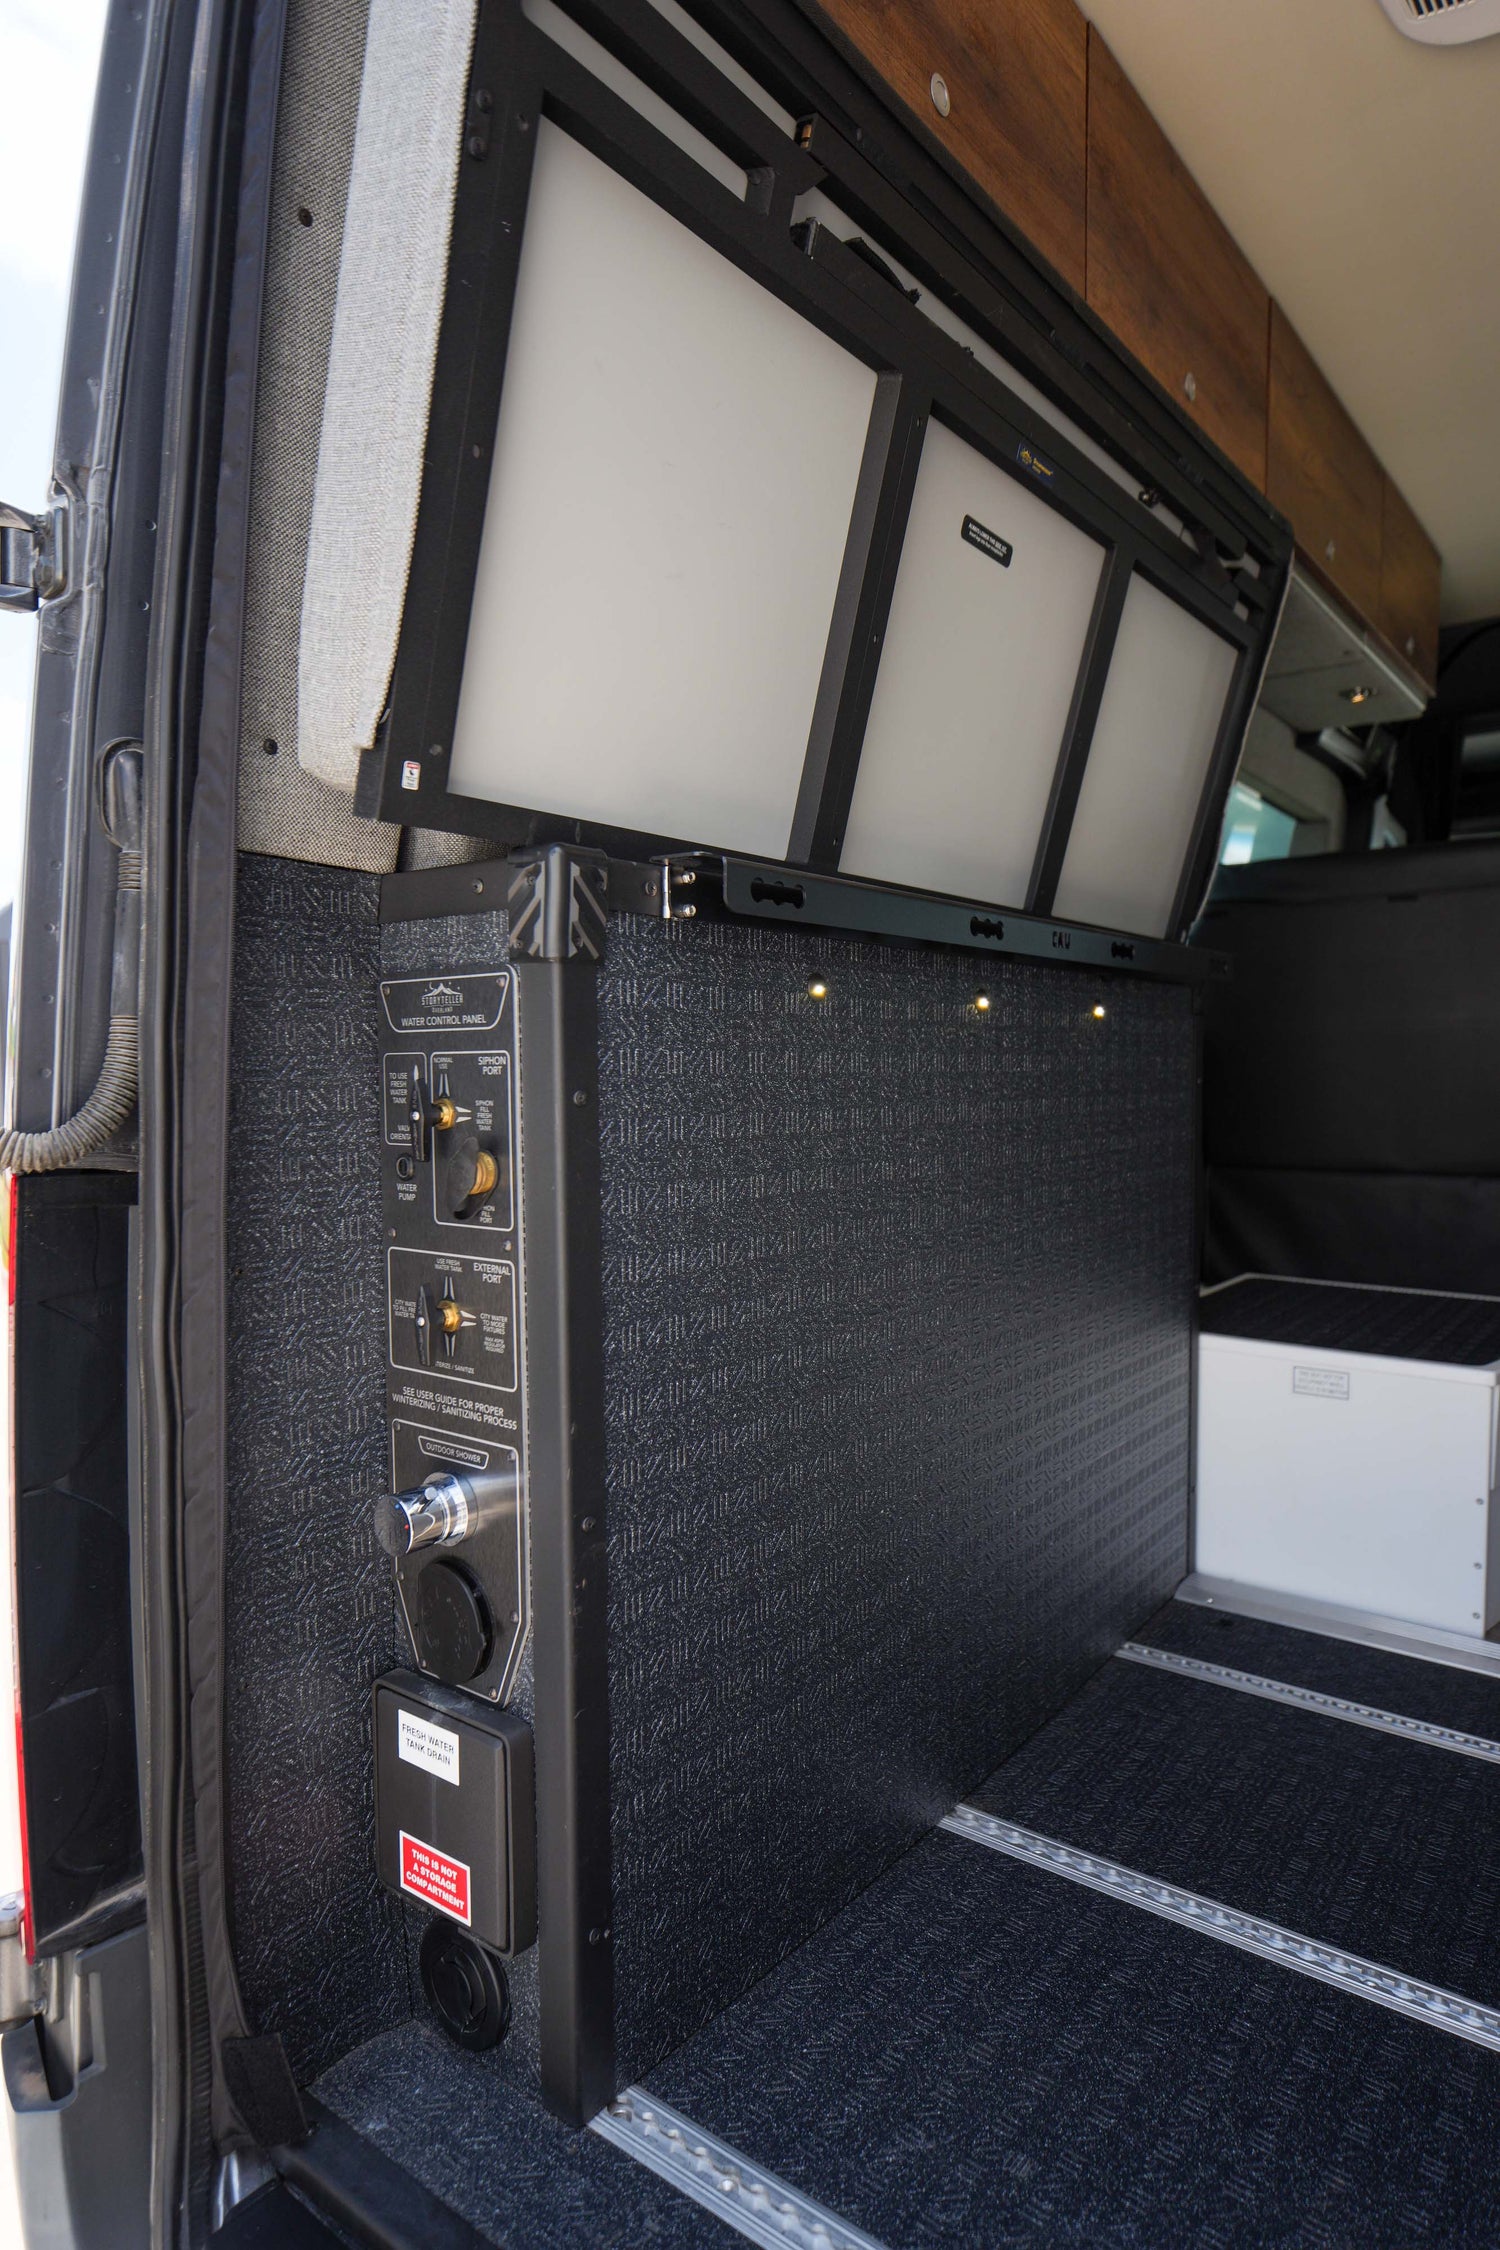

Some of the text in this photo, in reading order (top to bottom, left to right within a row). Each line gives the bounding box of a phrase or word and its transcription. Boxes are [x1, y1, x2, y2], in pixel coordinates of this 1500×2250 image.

[422, 994, 464, 1006] STORYTELLER
[402, 1014, 487, 1027] WATER CONTROL PANEL
[478, 1056, 506, 1066] SIPHON
[482, 1066, 502, 1075] PORT
[396, 1183, 418, 1192] WATER
[398, 1192, 416, 1200] PUMP
[474, 1262, 512, 1276] EXTERNAL
[482, 1273, 502, 1284] PORT
[483, 1326, 506, 1335] FIXTURES
[402, 1386, 504, 1417] SEE USER GUIDE FOR PROPER
[392, 1393, 436, 1411] WINTERIZING
[442, 1405, 482, 1422] SANITIZING
[483, 1415, 518, 1430] PROCESS
[426, 1442, 481, 1464] OUTDOOR SHOWER
[402, 1723, 454, 1755] FRESH WATER
[406, 1738, 450, 1766] TANK DRAIN
[412, 1848, 458, 1880] THIS IS NOT
[413, 1862, 456, 1894] A STORAGE
[406, 1870, 464, 1910] COMPARTMENT
